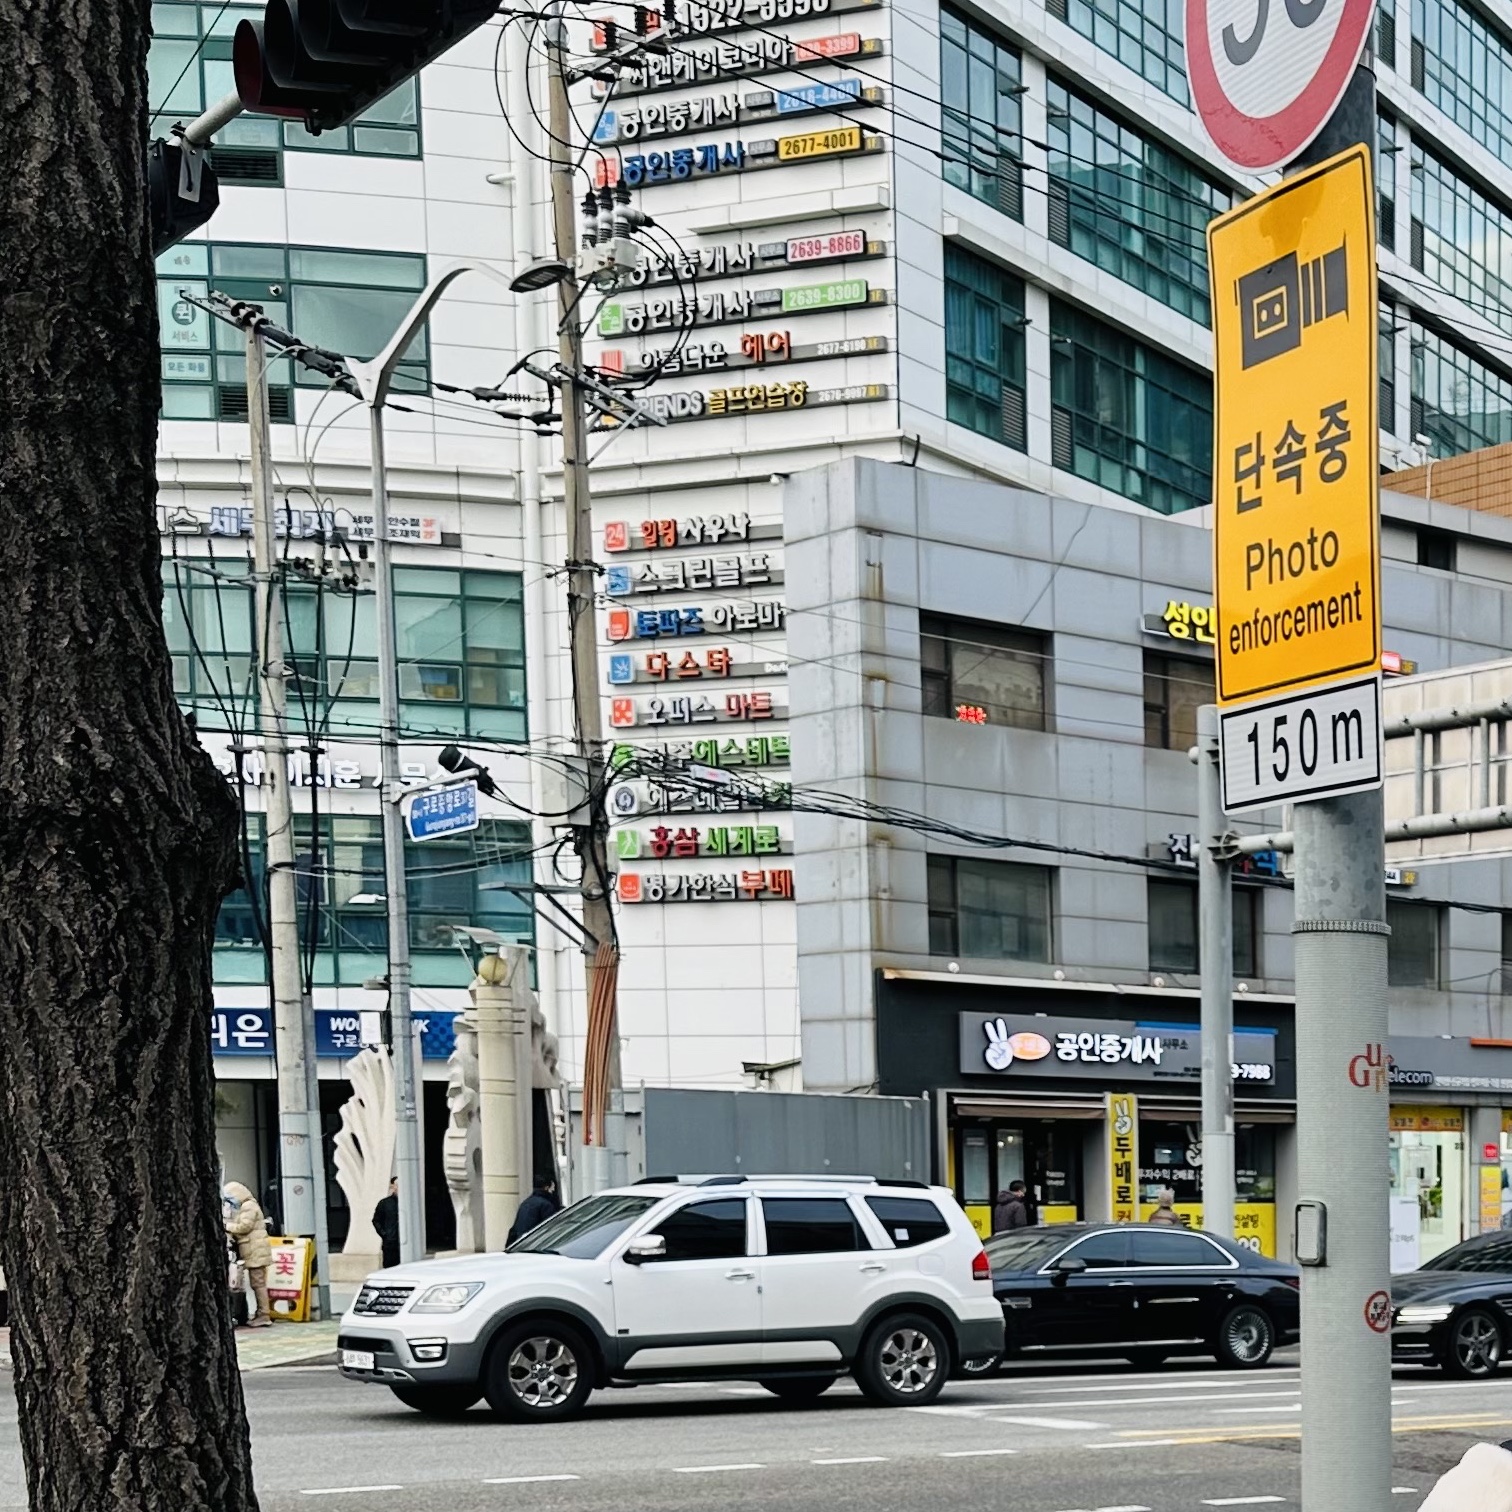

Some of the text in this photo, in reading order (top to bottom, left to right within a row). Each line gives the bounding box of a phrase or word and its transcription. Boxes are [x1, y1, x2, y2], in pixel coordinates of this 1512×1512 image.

[620, 94, 740, 138] 공인중개사
[624, 141, 745, 185] 공인중개사
[784, 132, 854, 156] 2677-4001
[791, 234, 860, 259] 2639-8866
[625, 290, 752, 332] 공인중개사
[789, 283, 861, 307] 2639-8300
[641, 341, 727, 375] 아름다운
[740, 330, 792, 363] 헤어
[708, 380, 809, 415] 골프연습장
[1234, 400, 1351, 514] 단속중
[682, 512, 751, 544] 사우나
[635, 554, 771, 592] 스크린골프
[1246, 527, 1339, 591] Photo
[636, 601, 787, 638] 토파즈 아로마
[1230, 582, 1362, 654] enforcement
[644, 692, 774, 724] 오피스 마트
[649, 824, 782, 858] 홍삼 세계로
[644, 869, 793, 902] 명가한식 부페
[1055, 1032, 1163, 1064] 공인중개사
[1115, 1136, 1132, 1204] 두배로
[276, 1252, 297, 1275] 꽃
